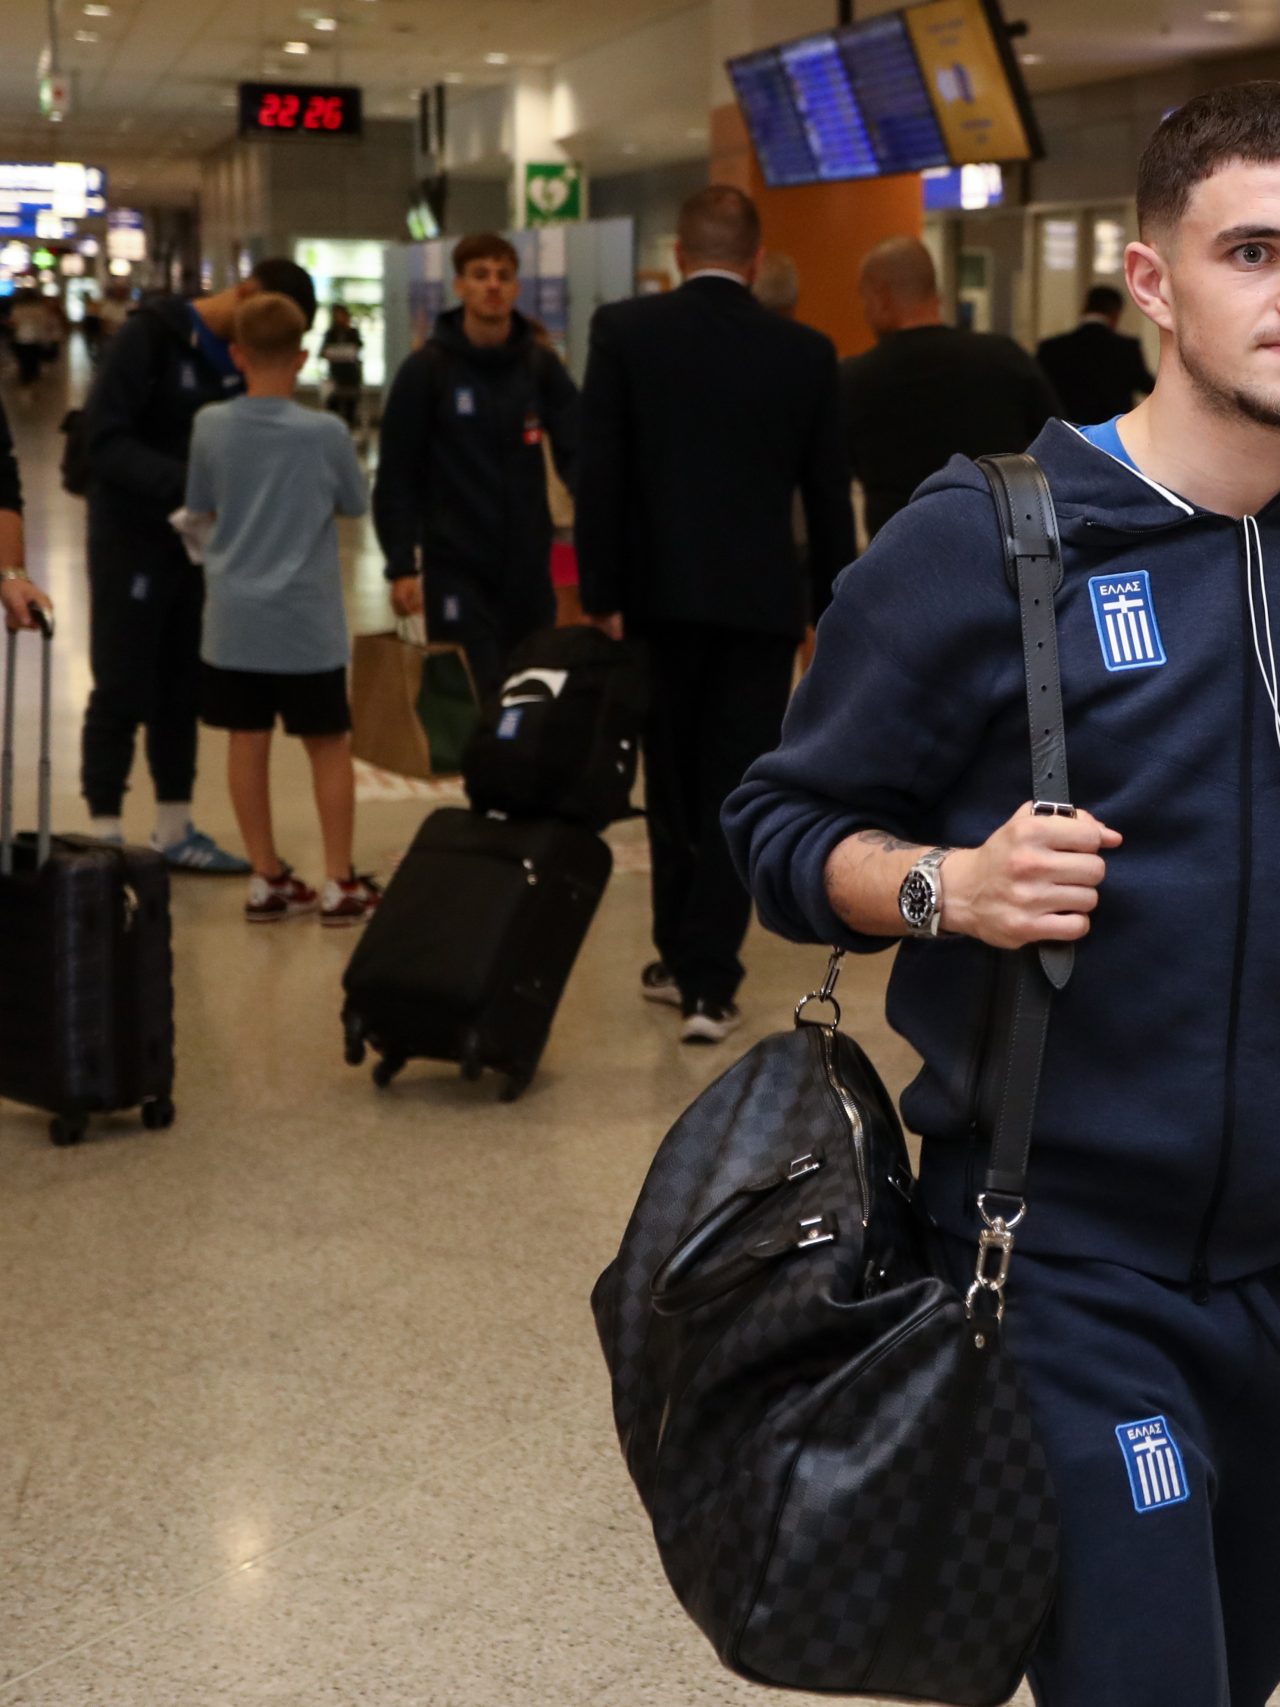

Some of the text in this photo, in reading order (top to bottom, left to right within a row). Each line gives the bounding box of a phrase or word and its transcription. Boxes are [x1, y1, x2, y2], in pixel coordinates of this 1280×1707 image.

[258, 93, 343, 130] 22 26
[1099, 581, 1141, 596] ΕΛΛΑΣ
[1127, 1423, 1162, 1440] ΕΛΛΑΣ
